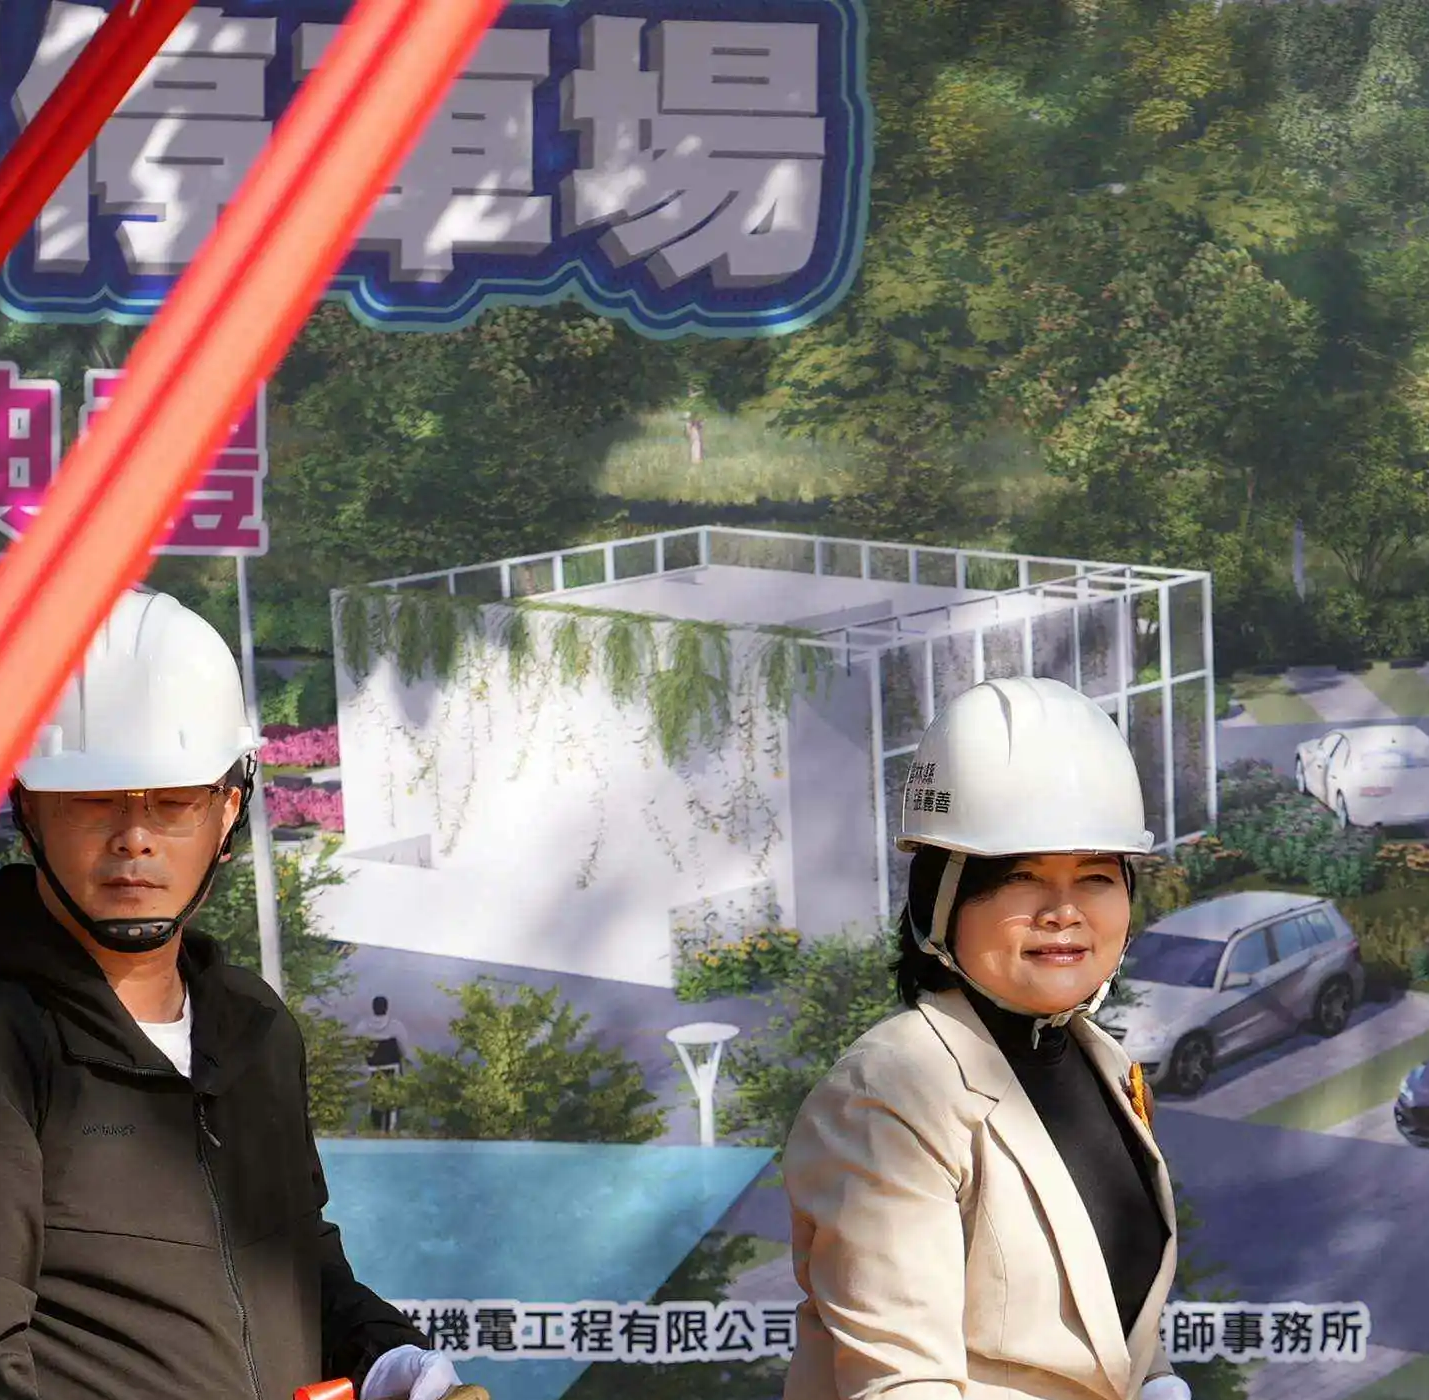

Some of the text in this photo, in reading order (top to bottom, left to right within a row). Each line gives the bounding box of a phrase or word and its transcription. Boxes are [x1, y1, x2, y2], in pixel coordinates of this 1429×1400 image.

[400, 1308, 797, 1354] 機電工程有限公司
[1160, 1310, 1363, 1355] 師事務所
